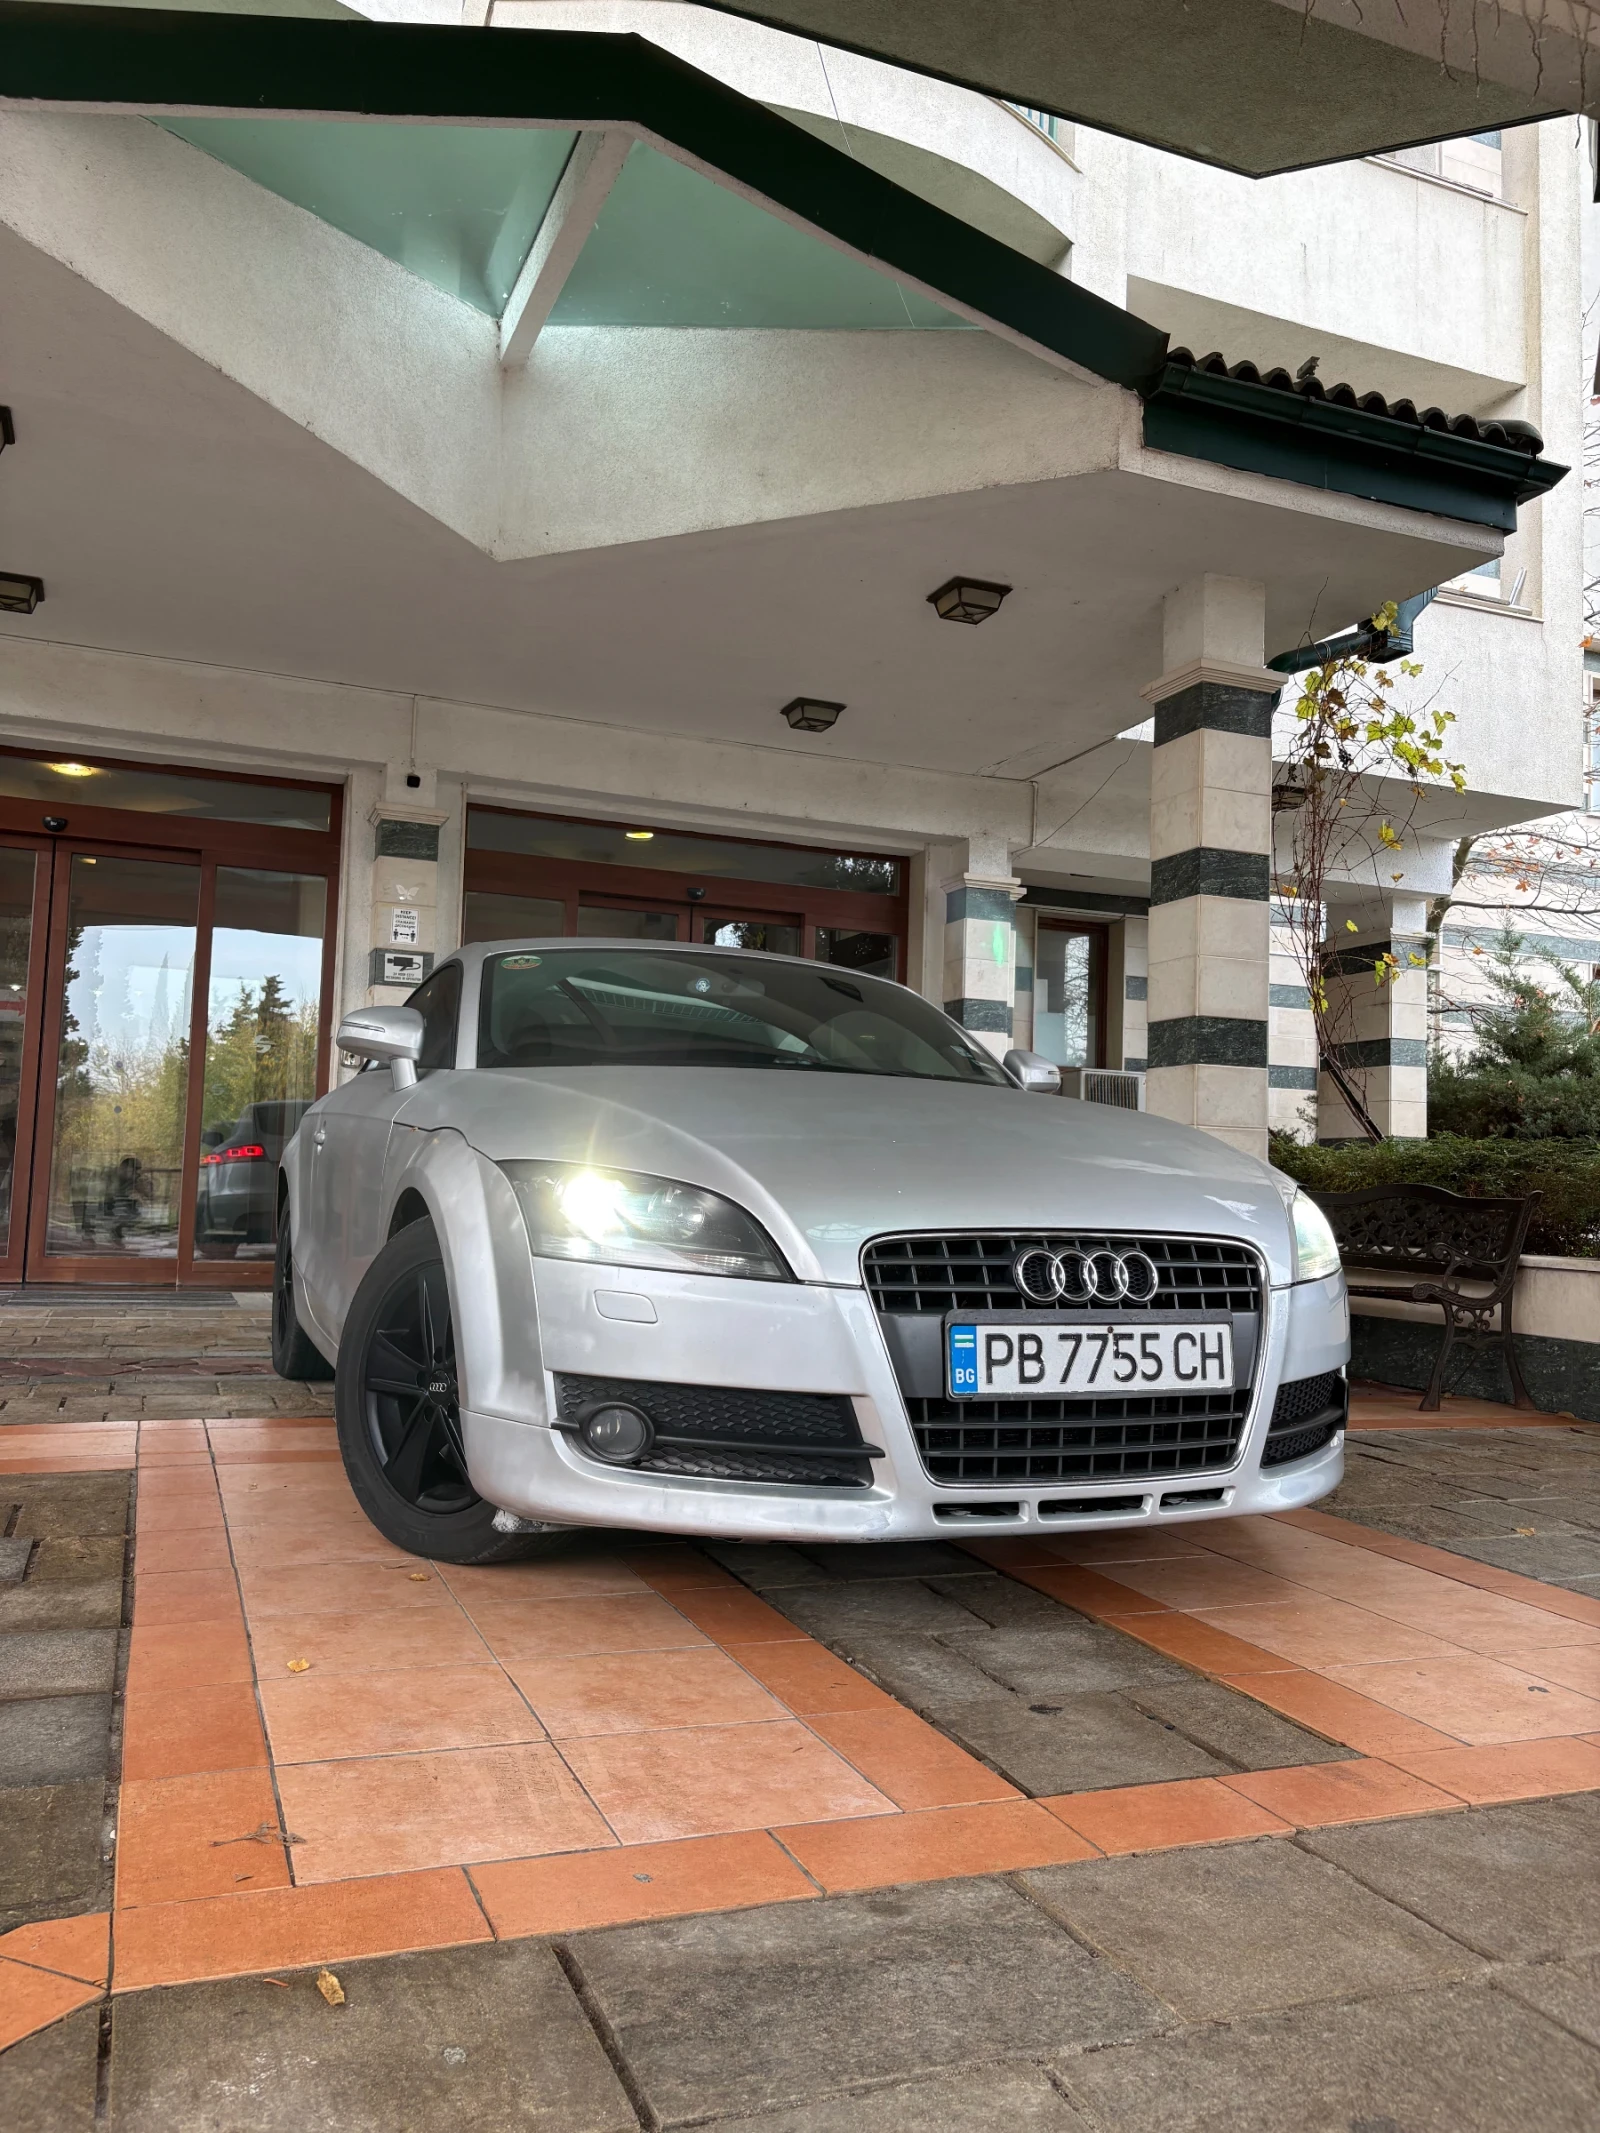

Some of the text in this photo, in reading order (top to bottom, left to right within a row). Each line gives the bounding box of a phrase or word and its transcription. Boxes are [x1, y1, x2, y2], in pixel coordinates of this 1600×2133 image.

[985, 1331, 1225, 1385] PB 7755 CH
[955, 1368, 975, 1384] BG
